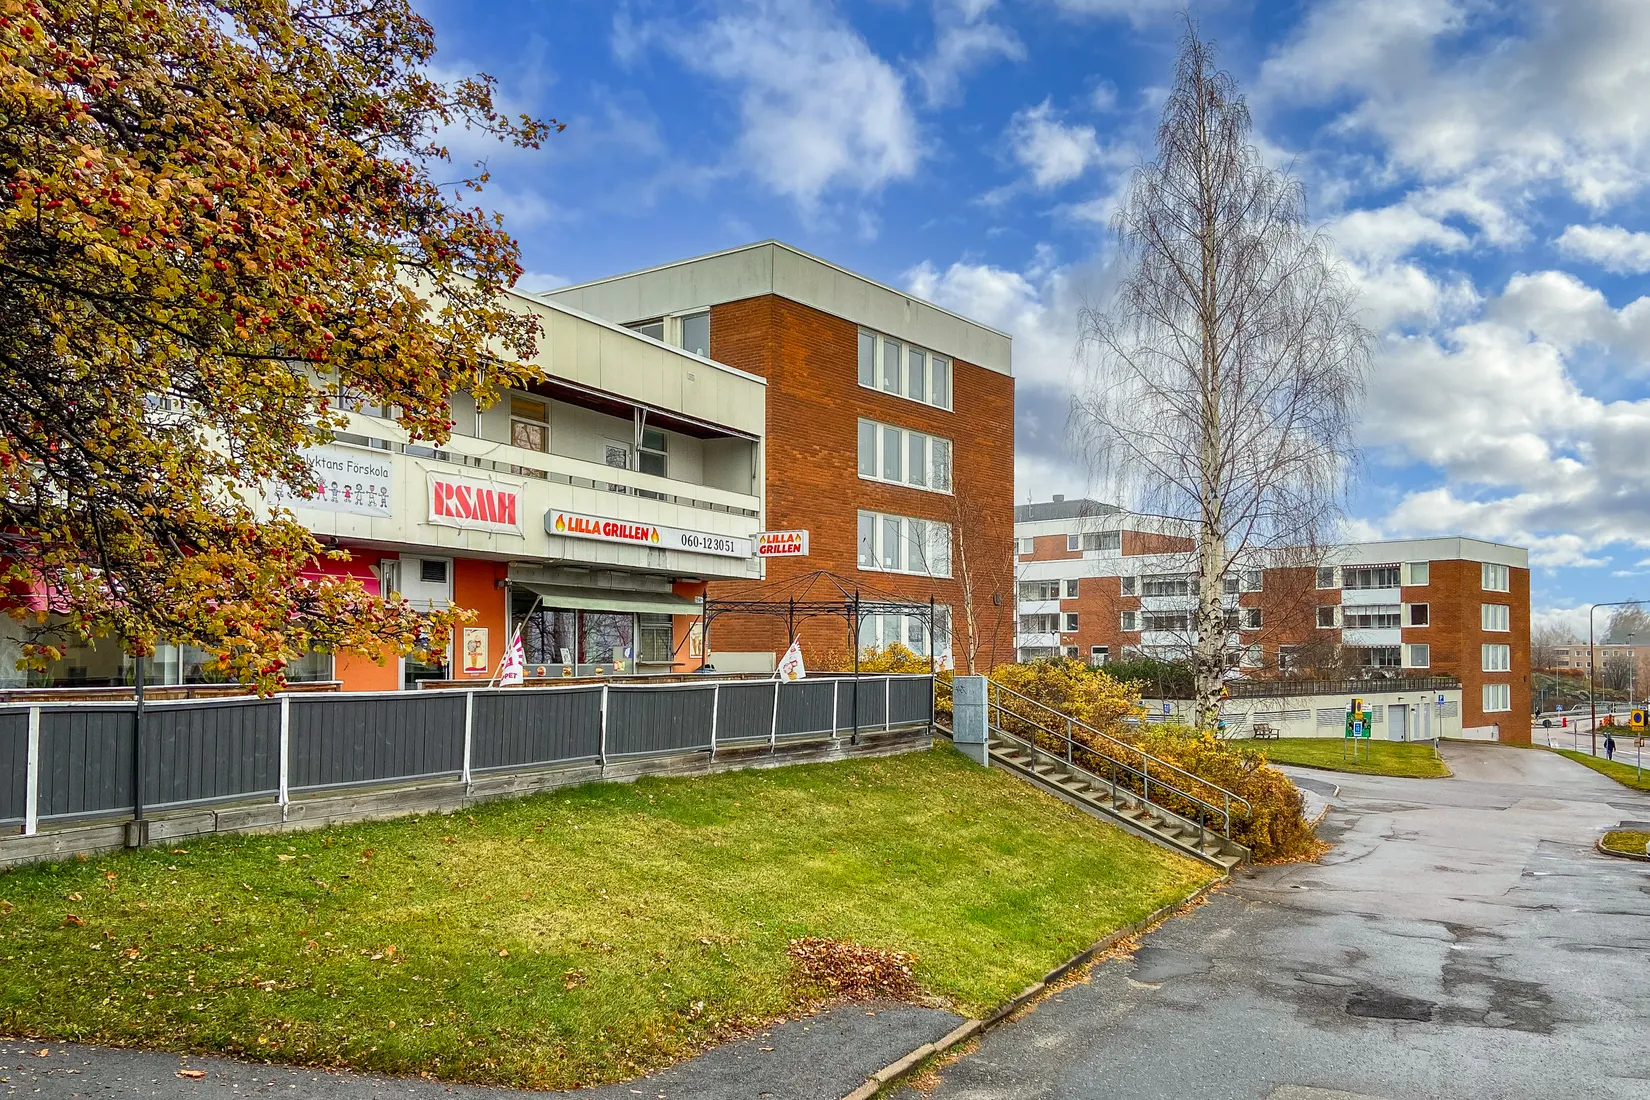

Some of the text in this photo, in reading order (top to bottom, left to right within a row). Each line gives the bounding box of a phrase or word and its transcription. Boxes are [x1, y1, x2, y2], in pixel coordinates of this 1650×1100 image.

[301, 454, 389, 478] lyktans Förskola
[434, 481, 516, 525] RSMH
[567, 517, 650, 541] LILLA GRILLEN
[767, 534, 794, 543] LILLA
[681, 534, 735, 552] 060-123051
[760, 544, 801, 554] GRILLEN
